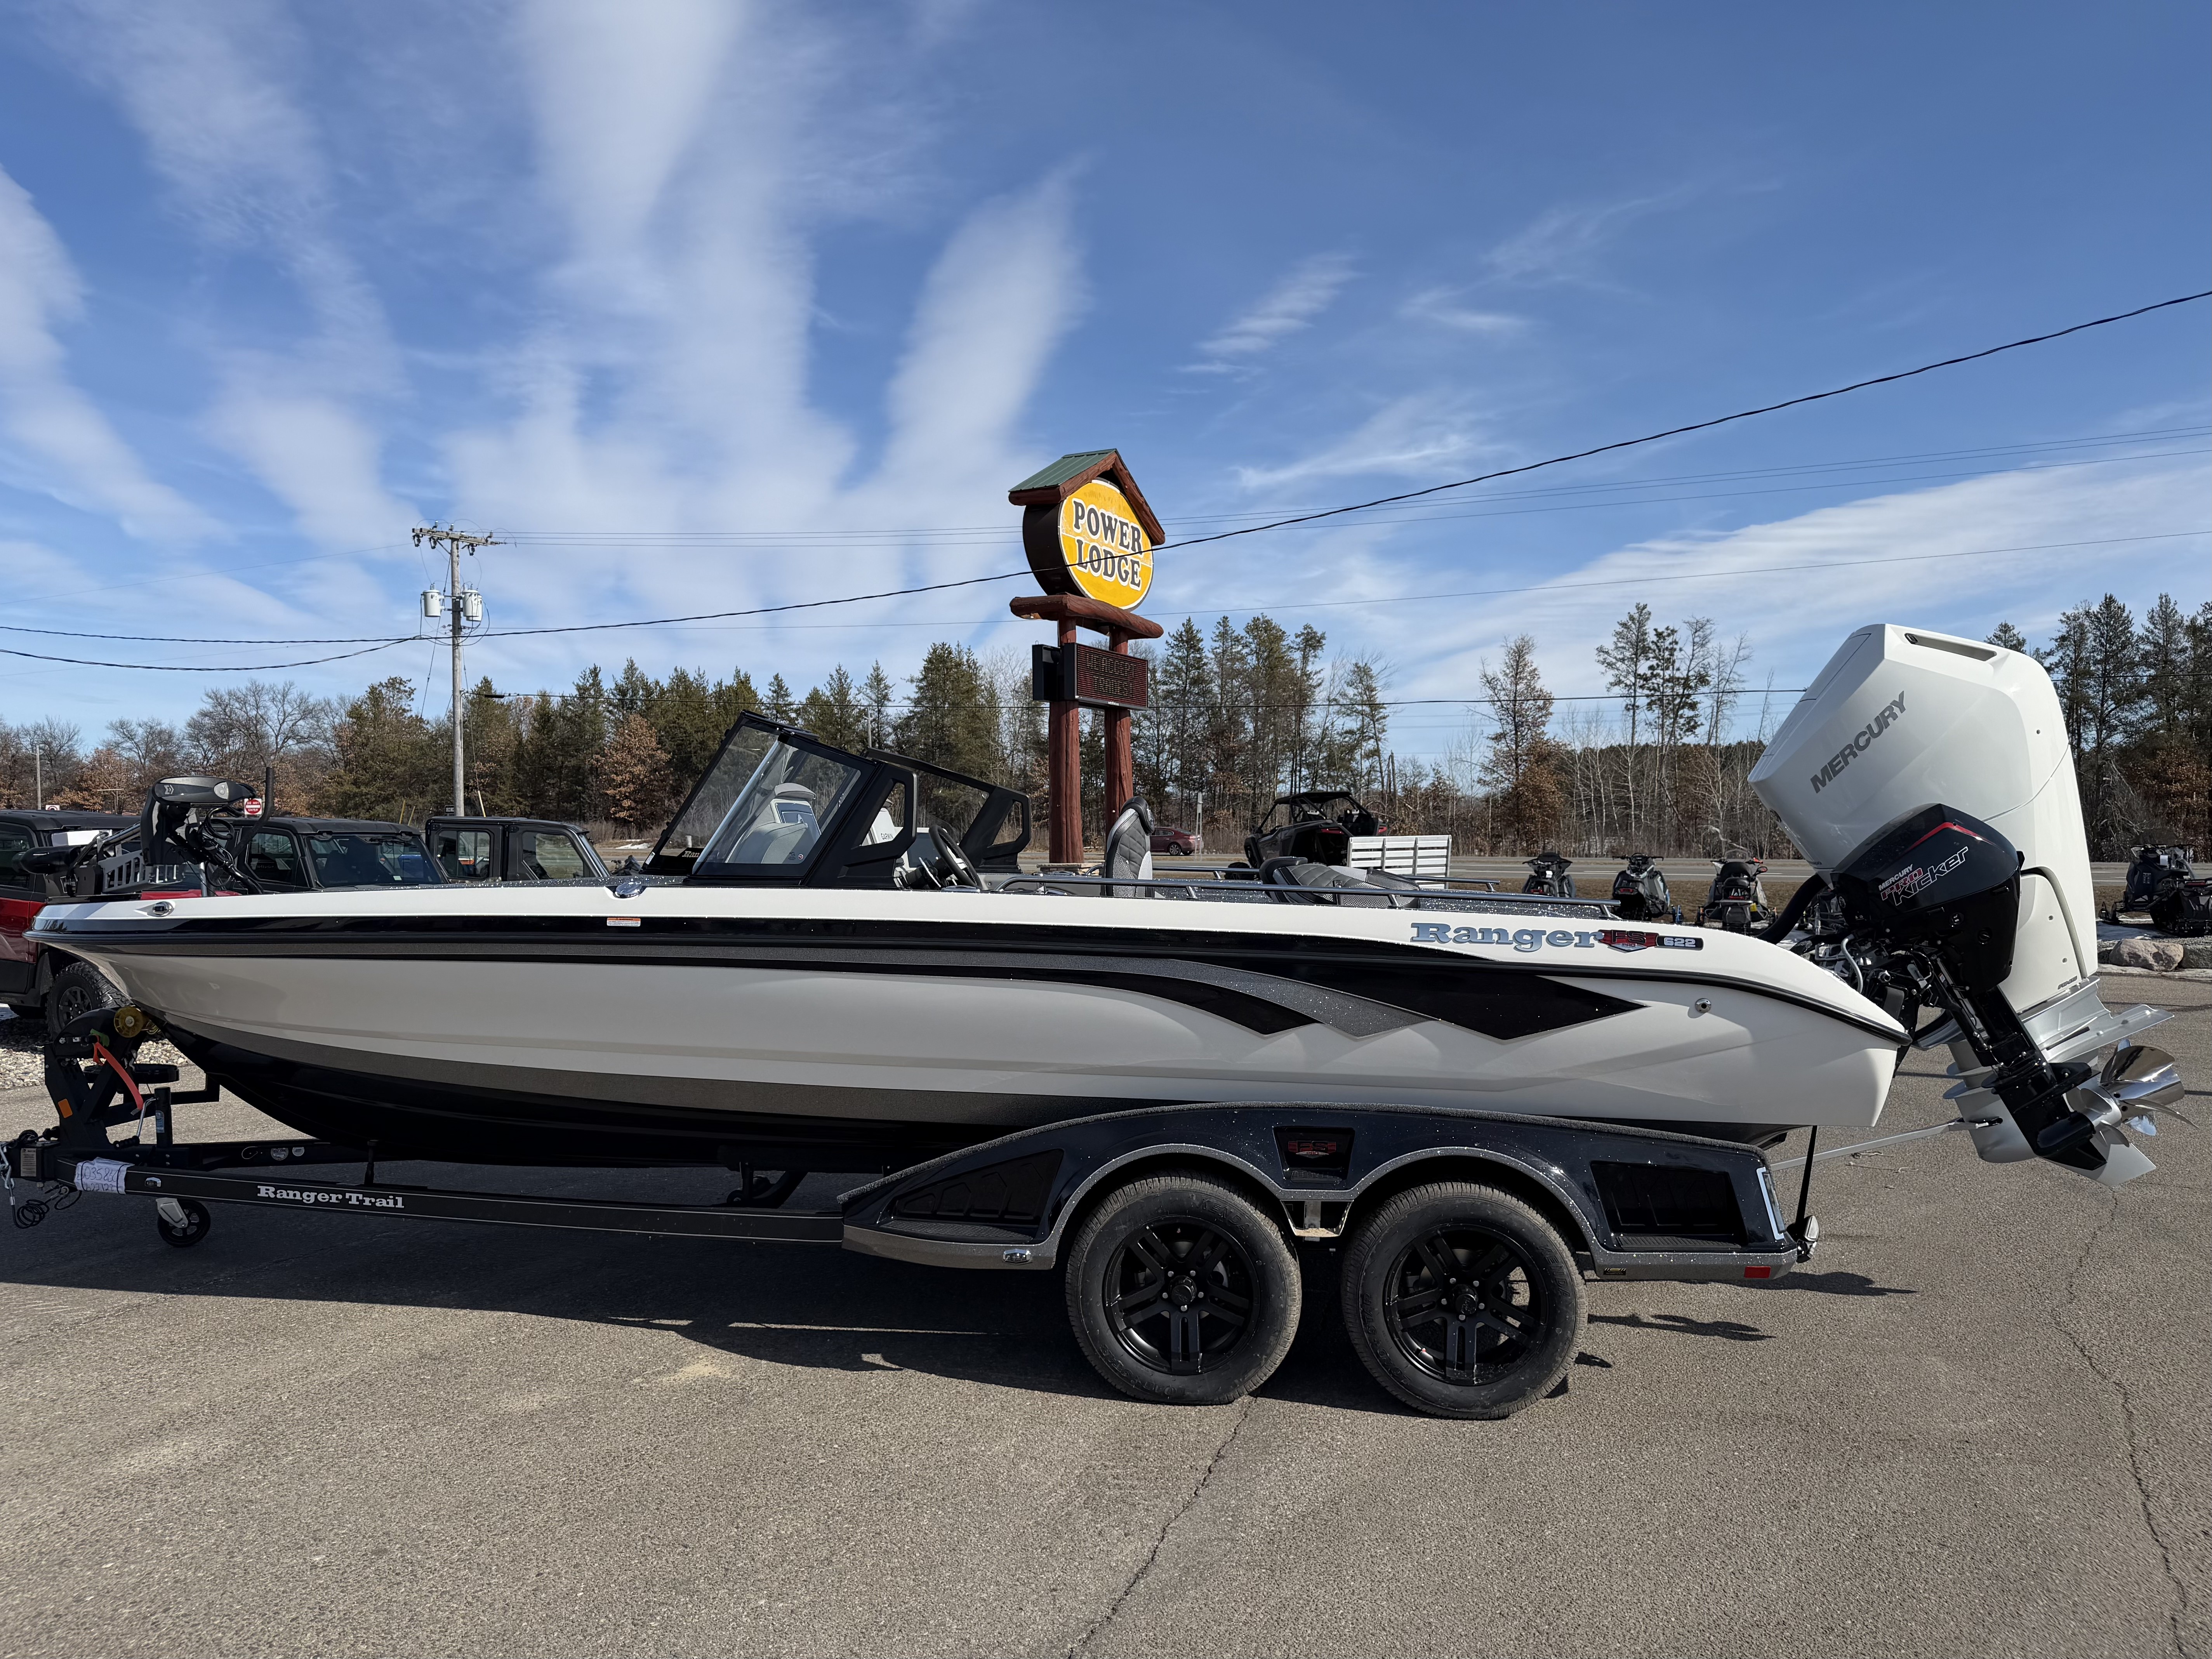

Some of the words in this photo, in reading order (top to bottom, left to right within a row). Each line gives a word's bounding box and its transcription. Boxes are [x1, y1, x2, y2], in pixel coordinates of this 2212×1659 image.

[1073, 500, 1143, 555] POWER
[1076, 539, 1141, 588] LODGE
[1810, 690, 1906, 794] MERCURY
[1878, 864, 1913, 891] MERCURY
[1881, 867, 1923, 901] PRO
[1410, 922, 1604, 952] Ranger
[1611, 929, 1646, 944] FS
[1664, 937, 1696, 947] 622
[257, 1185, 342, 1204] Ranger
[346, 1193, 405, 1208] Trail
[1197, 1199, 1250, 1233] KENDA
[1536, 1244, 1571, 1297] KENDA
